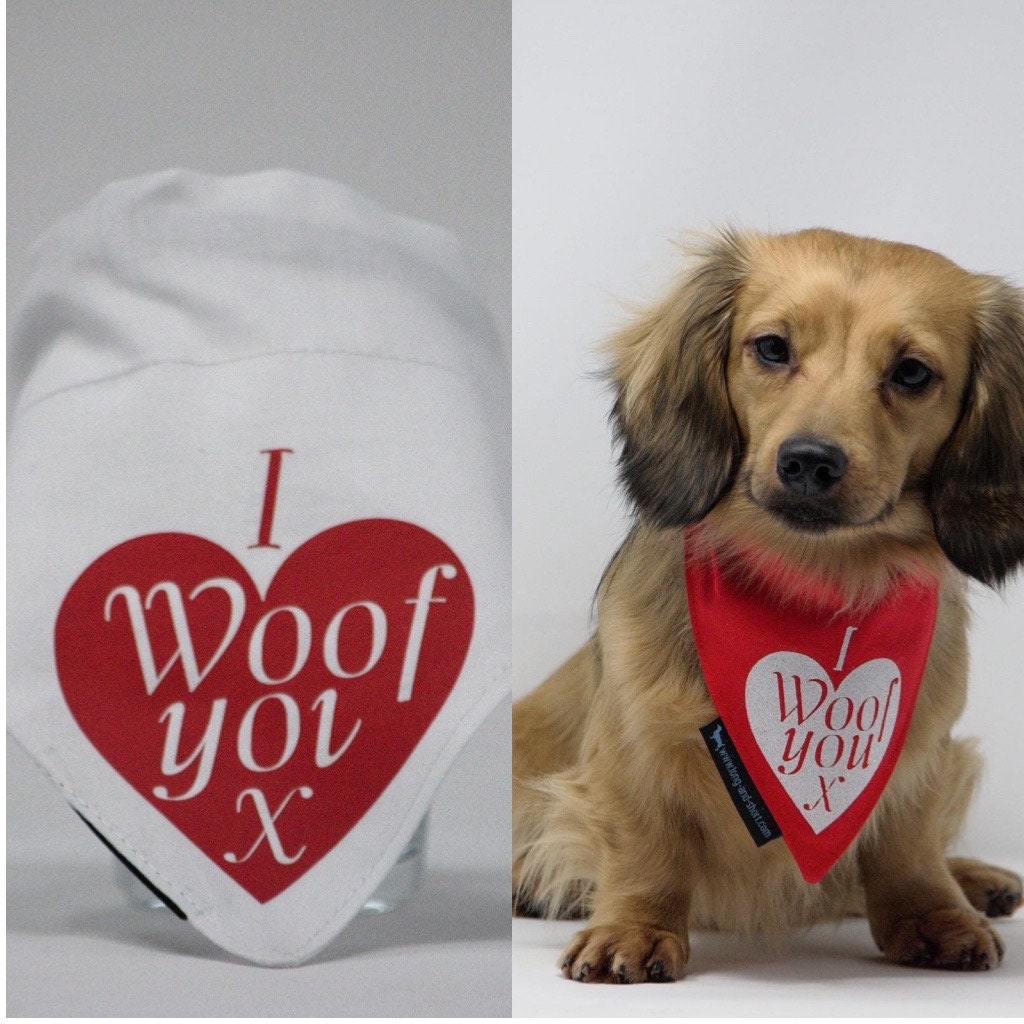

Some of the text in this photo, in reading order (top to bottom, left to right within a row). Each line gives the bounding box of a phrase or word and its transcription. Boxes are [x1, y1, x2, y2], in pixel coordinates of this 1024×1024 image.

[247, 449, 295, 549] I
[104, 563, 458, 702] Woof
[833, 626, 858, 671] I
[773, 671, 899, 743] Woof
[777, 727, 875, 776] you
